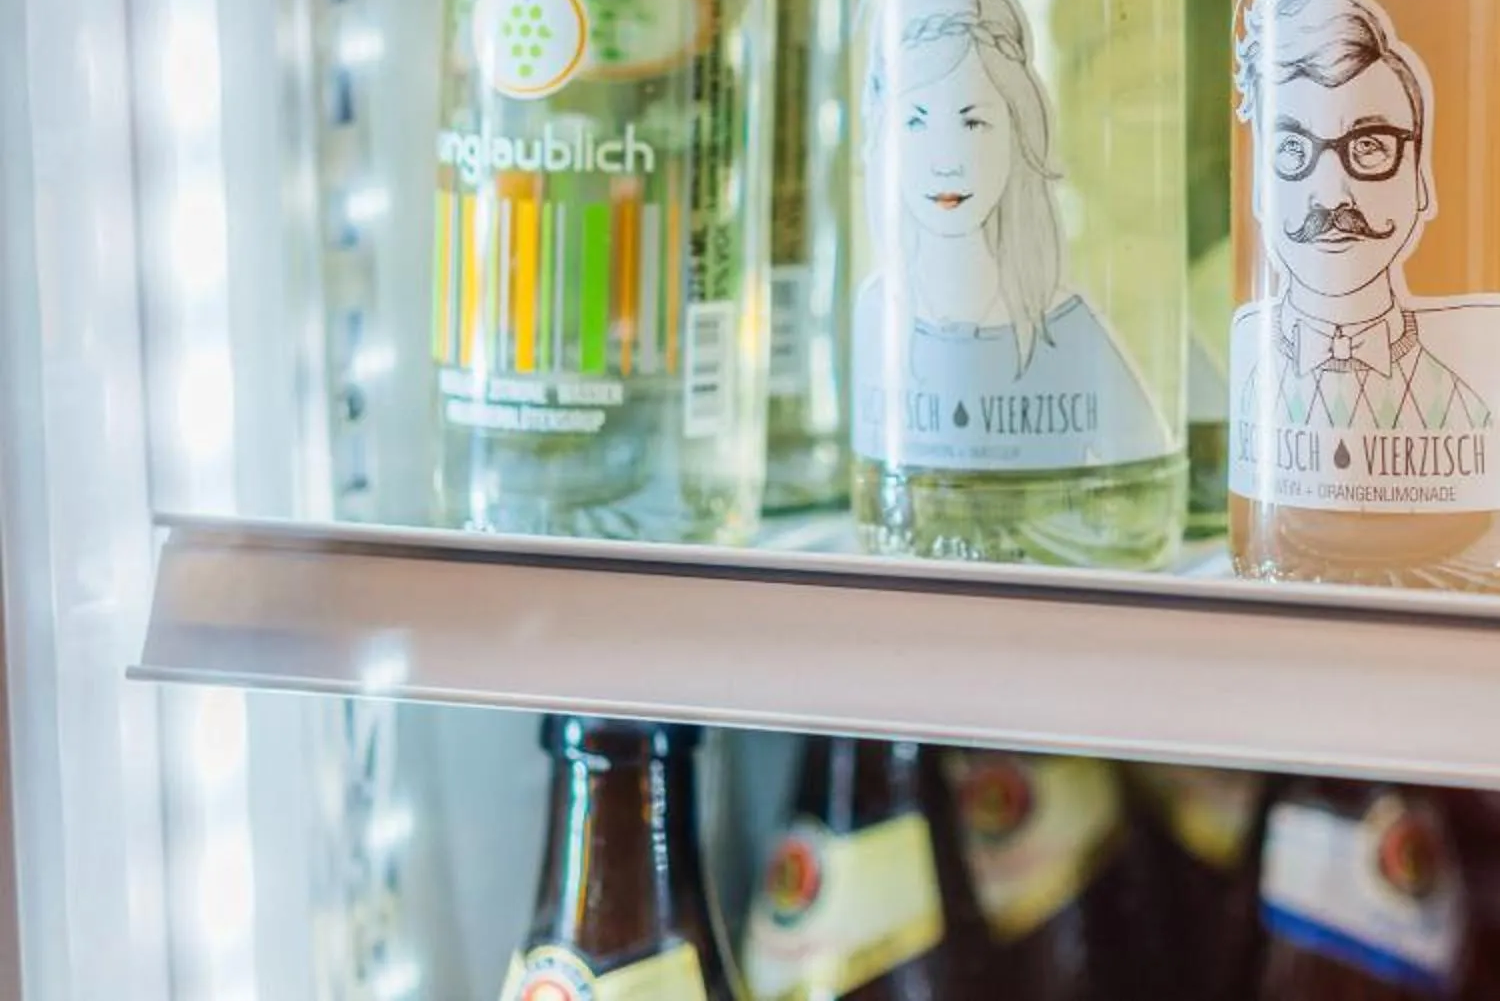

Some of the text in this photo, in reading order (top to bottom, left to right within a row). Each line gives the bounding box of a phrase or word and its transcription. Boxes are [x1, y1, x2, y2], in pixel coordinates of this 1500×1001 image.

[437, 123, 655, 183] nglaublich
[980, 392, 1098, 434] VIERZISCH
[1237, 427, 1486, 478] SECISCH VIERZISCH
[1317, 483, 1456, 502] ORANGENLIMONADE
